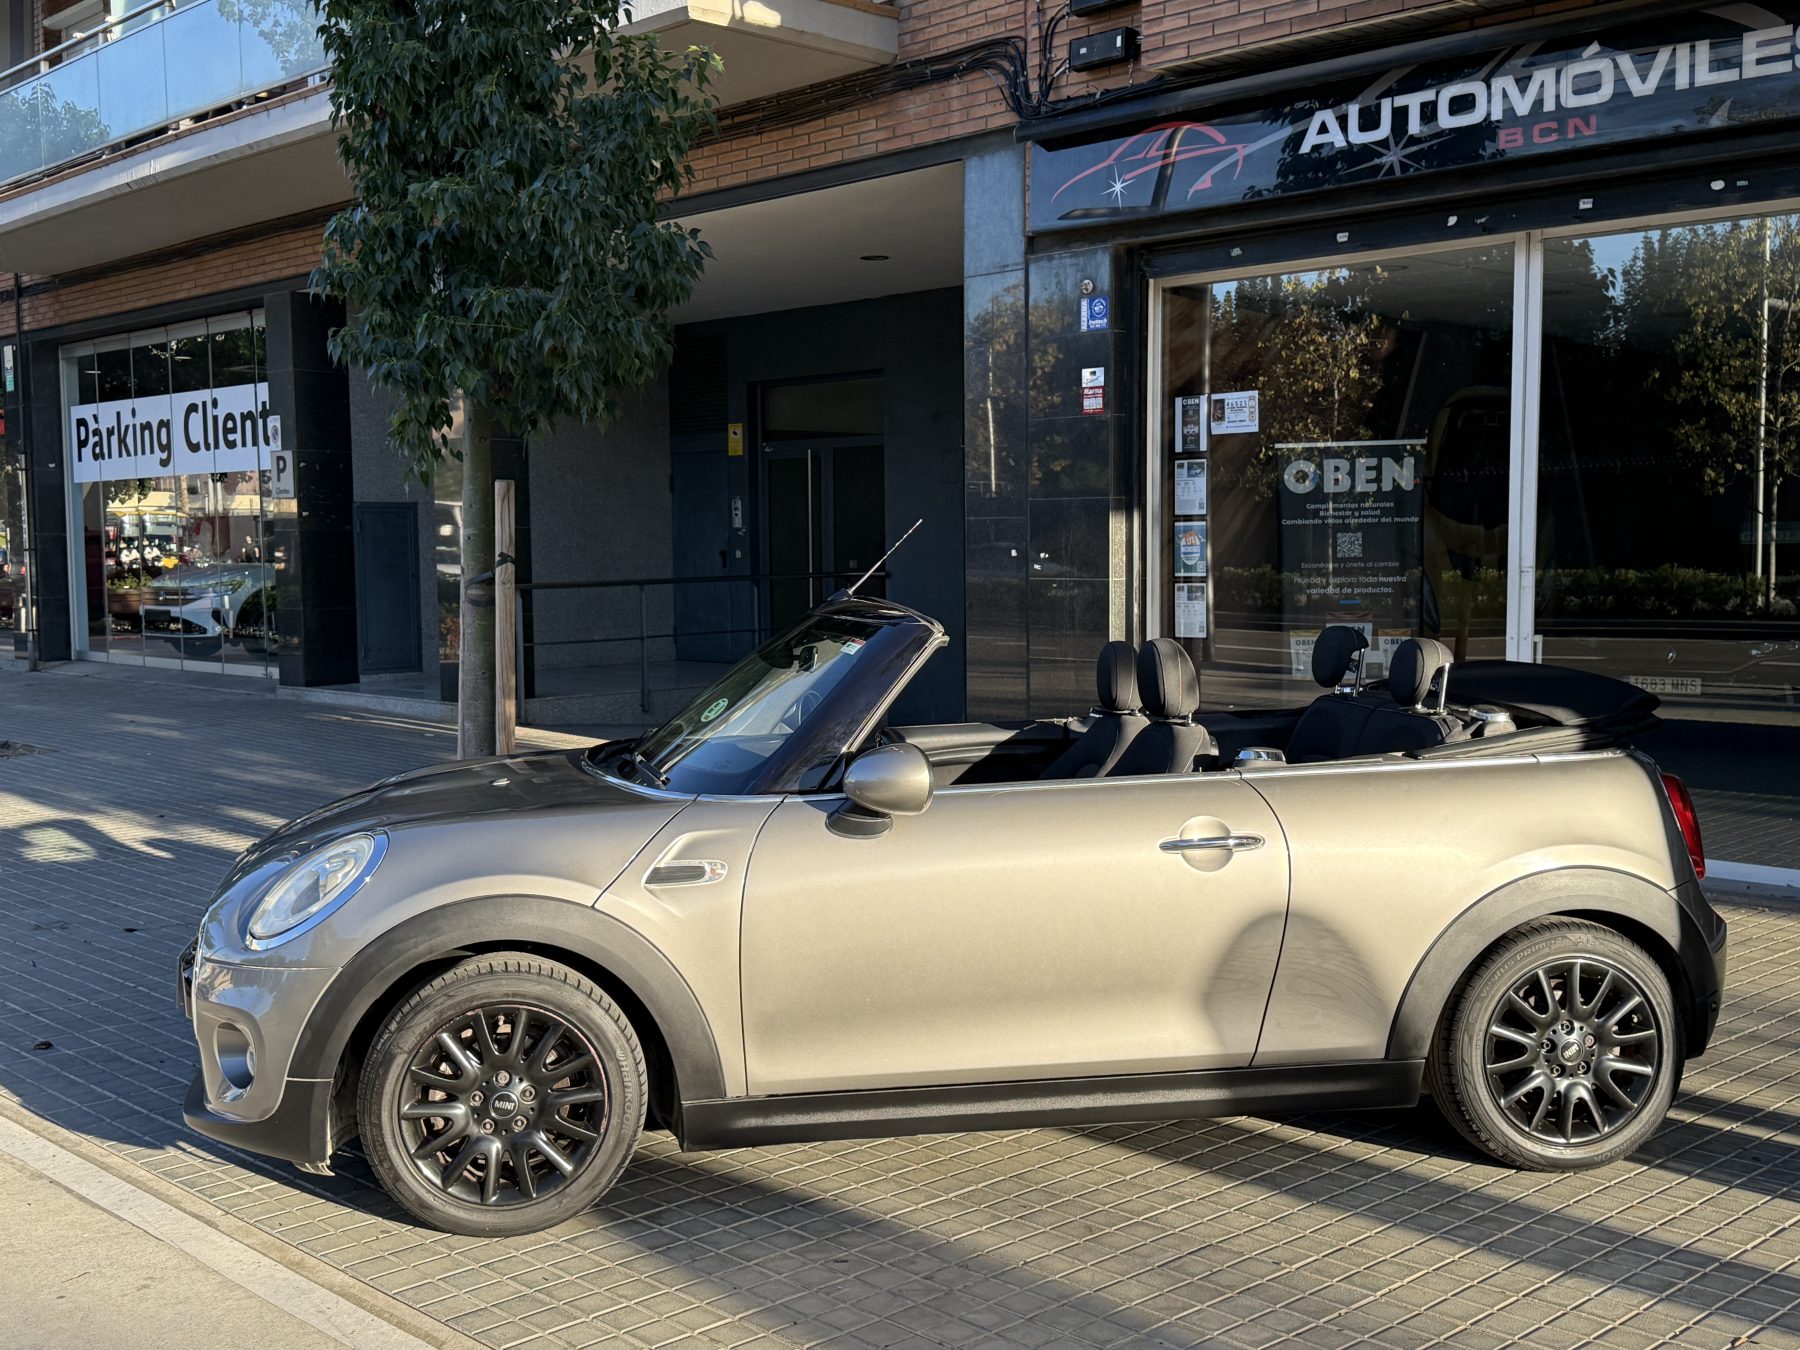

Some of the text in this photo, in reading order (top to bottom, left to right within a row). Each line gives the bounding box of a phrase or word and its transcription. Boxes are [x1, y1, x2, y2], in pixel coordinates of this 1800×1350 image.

[1298, 24, 1800, 155] AUTOMÓVILE
[1499, 115, 1597, 150] BCN
[1183, 397, 1200, 406] OBEN
[276, 455, 287, 482] P
[1283, 456, 1415, 494] OBEN
[1341, 586, 1352, 594] de
[1562, 1043, 1580, 1060] MINI
[494, 1099, 516, 1111] MINI
